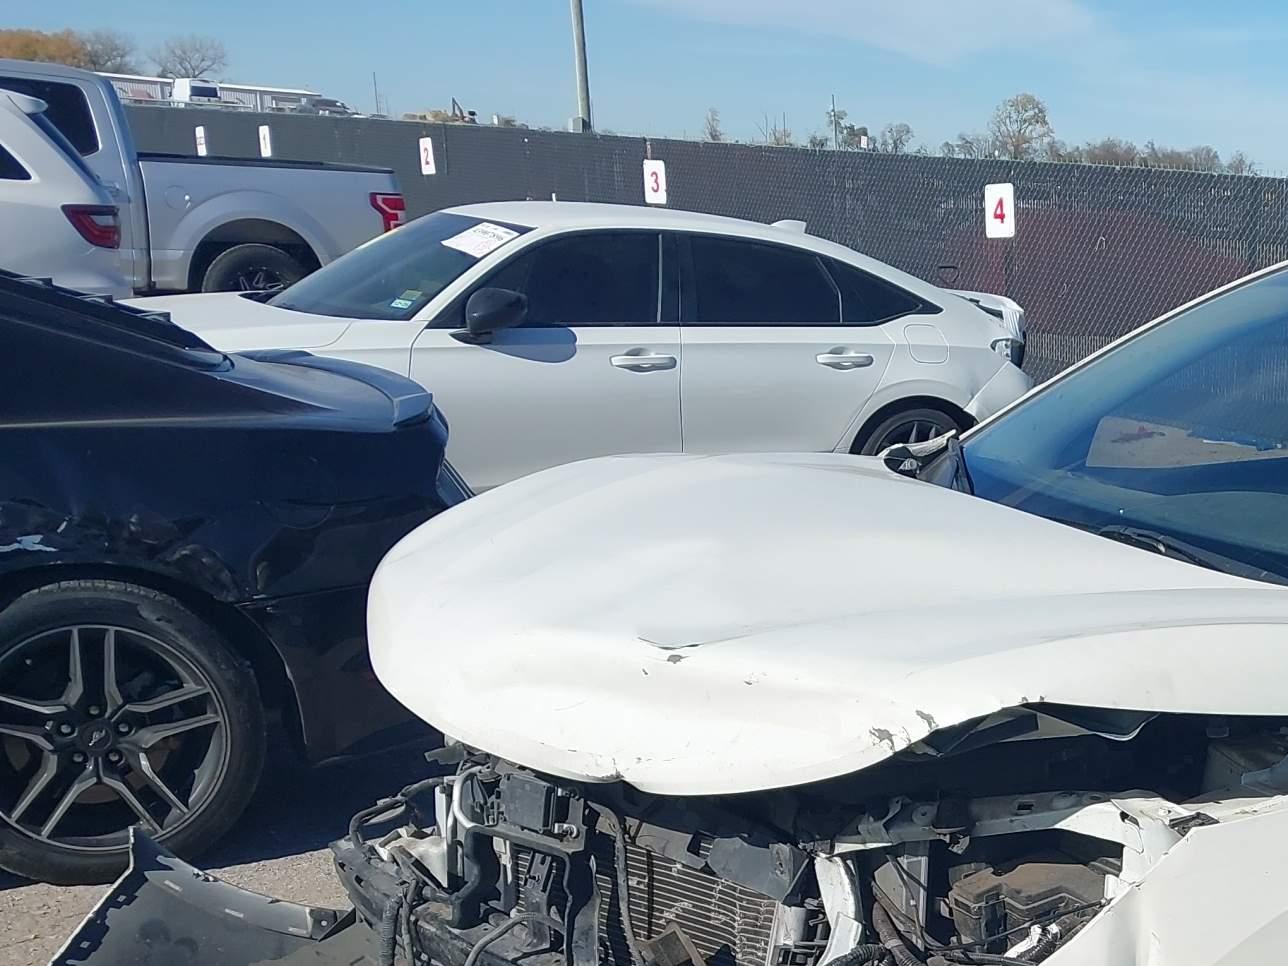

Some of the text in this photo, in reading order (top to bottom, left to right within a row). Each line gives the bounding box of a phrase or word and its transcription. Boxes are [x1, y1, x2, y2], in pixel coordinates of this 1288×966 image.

[423, 147, 430, 165] 2
[650, 171, 660, 193] 3
[993, 197, 1005, 224] 4
